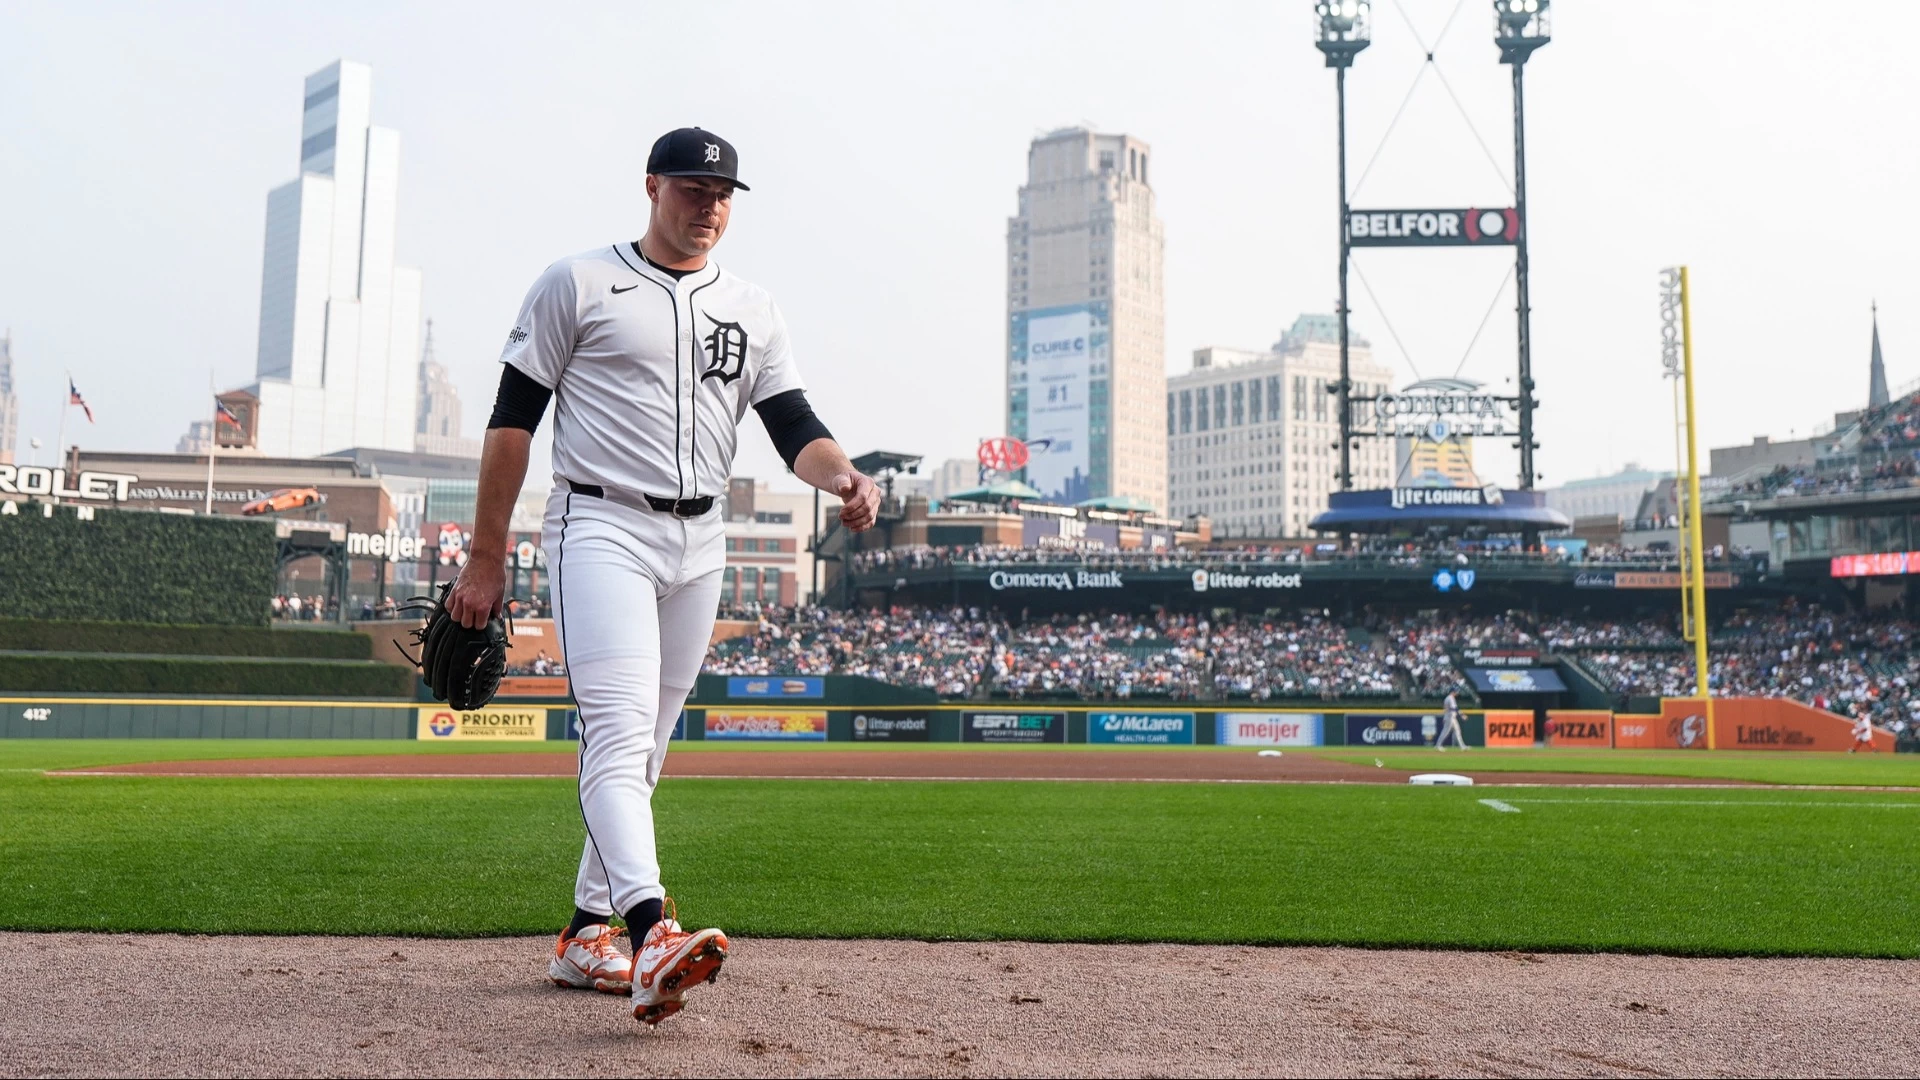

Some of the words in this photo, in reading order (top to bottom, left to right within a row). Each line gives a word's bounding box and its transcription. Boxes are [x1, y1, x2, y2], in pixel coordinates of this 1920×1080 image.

[704, 142, 720, 163] D
[1351, 213, 1459, 237] BELFOR
[509, 326, 528, 343] eijer
[701, 308, 748, 386] D
[1047, 385, 1068, 402] #1
[1425, 489, 1480, 504] LOUNGE
[346, 528, 426, 563] meijer
[990, 570, 1074, 590] Comerica
[1077, 571, 1123, 587] Bank
[461, 714, 535, 725] PRIORITY
[715, 713, 780, 734] Surfside
[1122, 716, 1184, 731] McLaren
[1114, 734, 1146, 742] HEALTH
[1148, 734, 1168, 742] CARE
[1238, 717, 1300, 743] meijer
[1362, 726, 1412, 744] Corona
[1489, 722, 1532, 738] PIZZA!
[1736, 725, 1781, 744] Little
